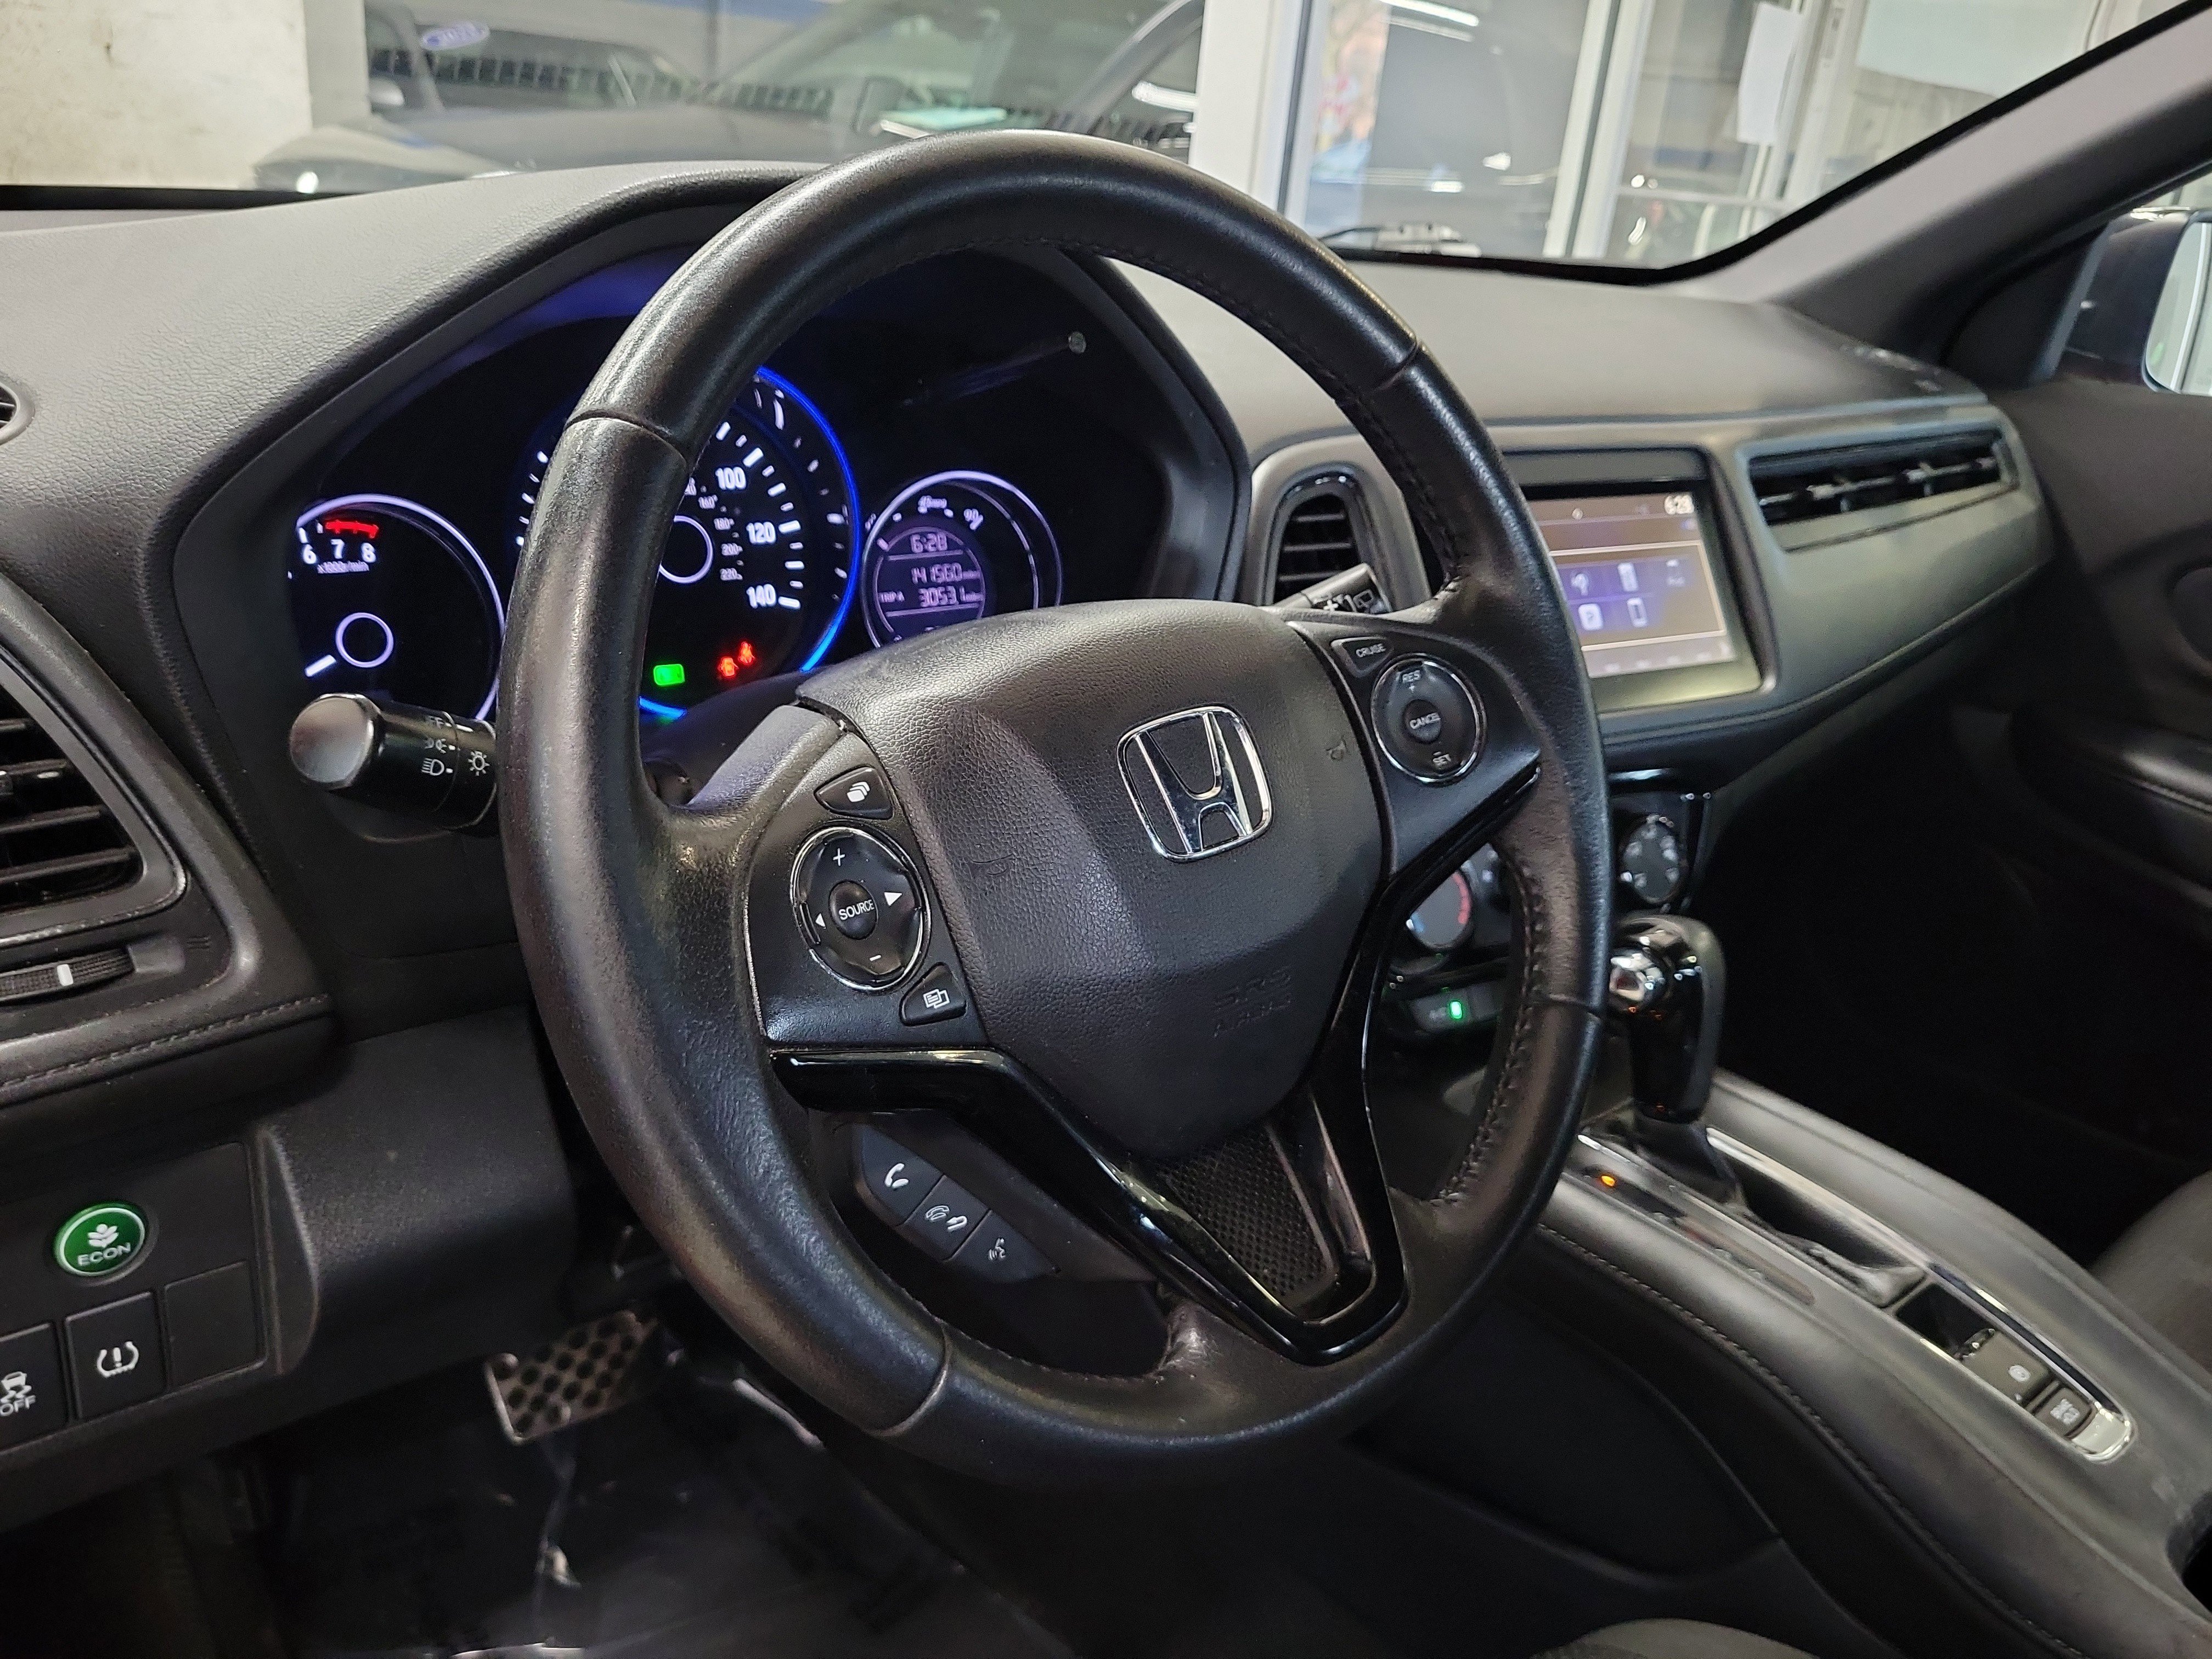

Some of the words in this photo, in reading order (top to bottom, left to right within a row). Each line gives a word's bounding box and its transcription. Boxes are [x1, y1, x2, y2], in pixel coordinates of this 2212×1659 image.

[715, 467, 747, 490] 100
[746, 521, 776, 544] 120
[302, 544, 318, 565] 6
[330, 539, 345, 559] 7
[360, 542, 376, 563] 8
[746, 583, 777, 608] 140
[838, 899, 876, 921] SOURCE
[77, 1242, 131, 1266] ECON
[0, 1395, 36, 1417] OFF
